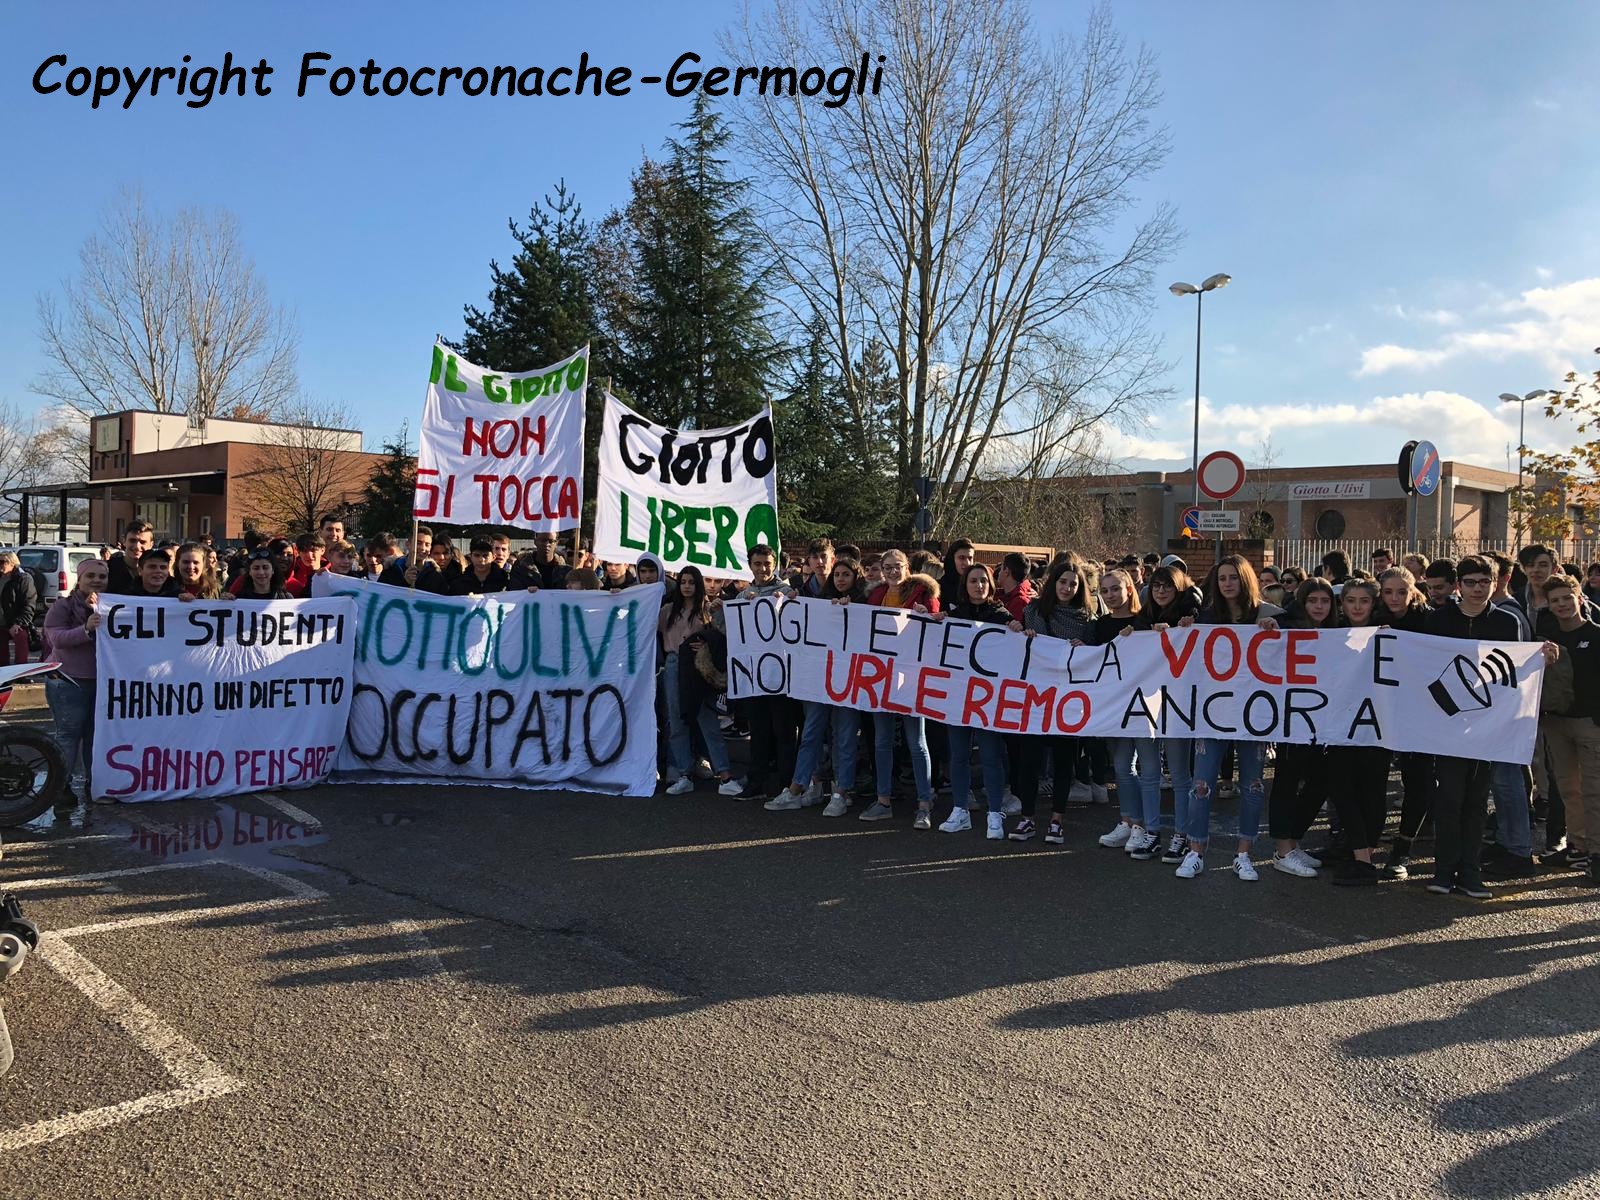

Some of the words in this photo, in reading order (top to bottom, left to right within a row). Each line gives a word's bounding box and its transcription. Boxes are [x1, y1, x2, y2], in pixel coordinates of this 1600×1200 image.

[430, 346, 467, 392] IL
[482, 356, 587, 404] GIOTTO
[462, 415, 546, 459] NON
[473, 475, 579, 521] TOCCA
[1293, 484, 1330, 496] Giotto
[1334, 483, 1365, 494] Ulivi
[620, 490, 778, 571] LIBERO
[107, 604, 165, 640] GLI
[185, 609, 345, 647] STUDENTI
[731, 652, 791, 695] NOI
[1066, 641, 1122, 684] LA
[1160, 626, 1319, 685] VOCE
[1373, 634, 1400, 687] E
[107, 678, 204, 720] HANNO
[214, 681, 243, 711] UN
[249, 676, 345, 710] DIFETTO
[348, 683, 627, 769] OCCUPATO
[105, 744, 225, 796] SANNO
[235, 745, 336, 787] PENSARE
